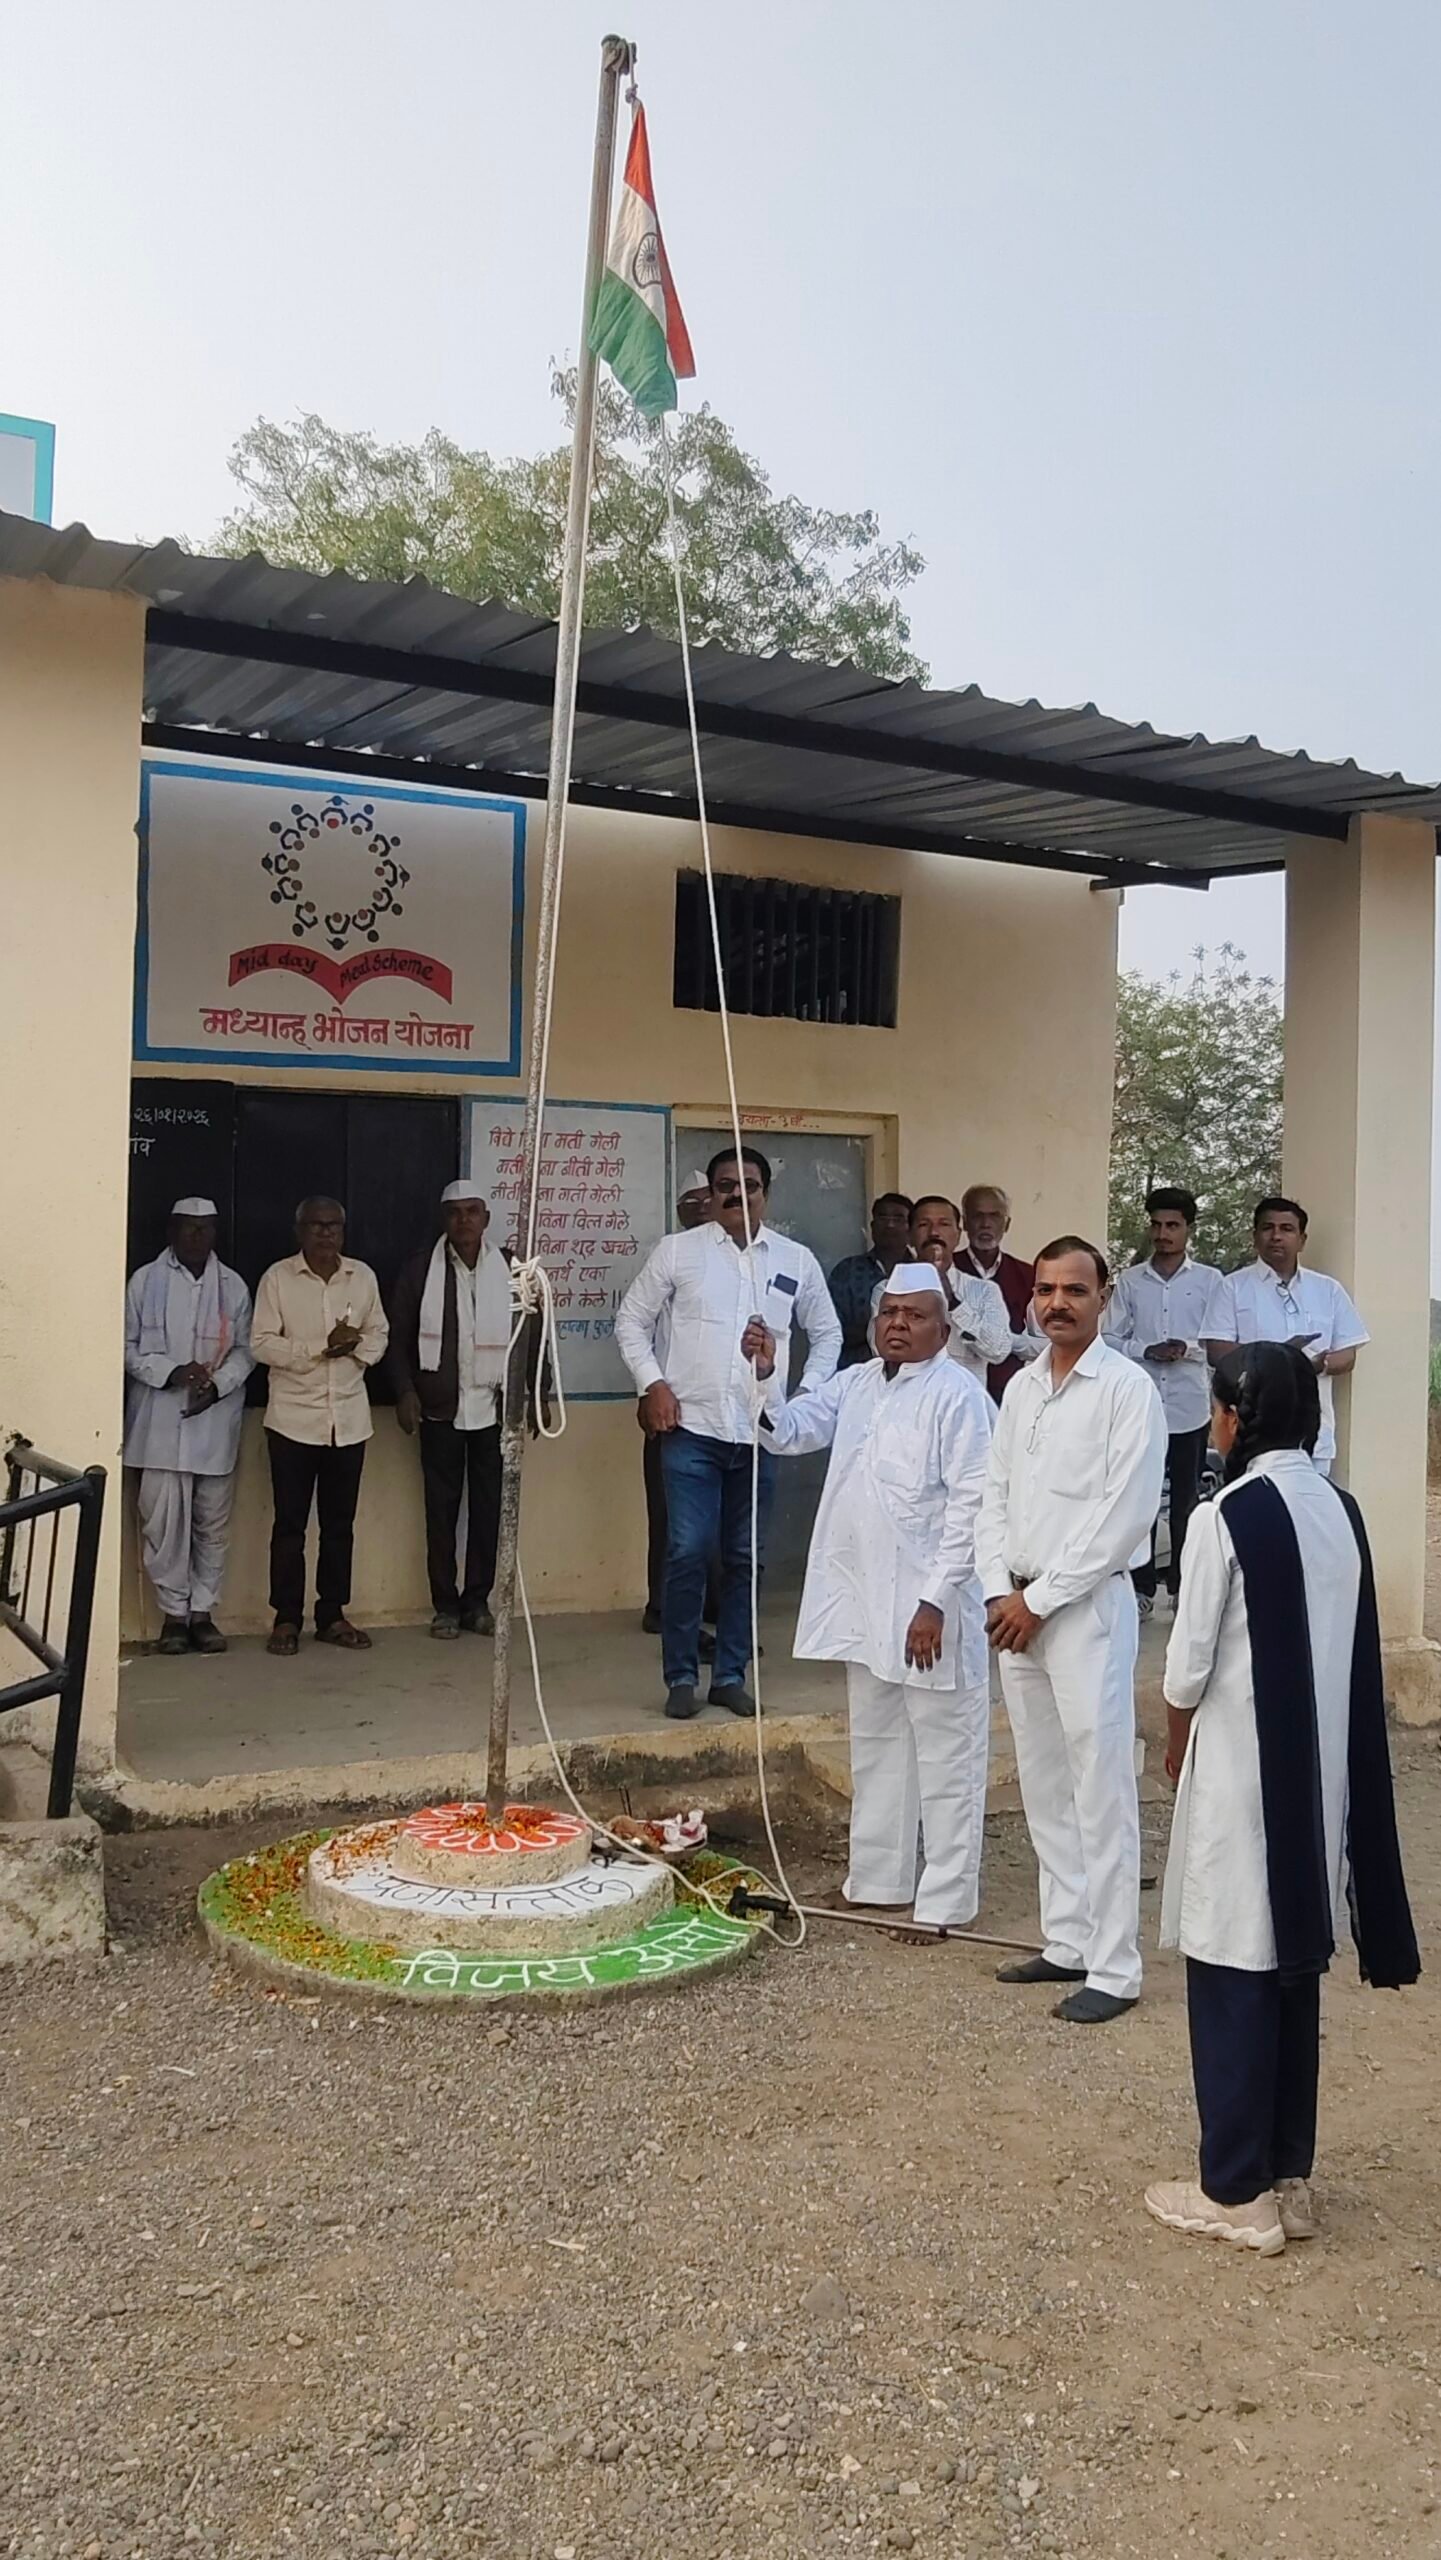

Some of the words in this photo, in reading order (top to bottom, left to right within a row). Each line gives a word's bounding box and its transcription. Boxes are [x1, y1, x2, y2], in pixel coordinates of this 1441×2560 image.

[237, 950, 269, 974] Mid
[278, 952, 318, 974] day
[340, 957, 369, 988] Meal
[373, 952, 434, 981] Scheme
[313, 1007, 390, 1045] भोजन
[395, 1012, 474, 1050] योजना
[554, 1129, 586, 1149] मती
[590, 1130, 622, 1151] गेली
[595, 1156, 625, 1178] गेली
[590, 1184, 624, 1203] गेली
[543, 1259, 575, 1283] नर्थ
[391, 1949, 599, 1989] विजय
[599, 1917, 748, 1974] असो
